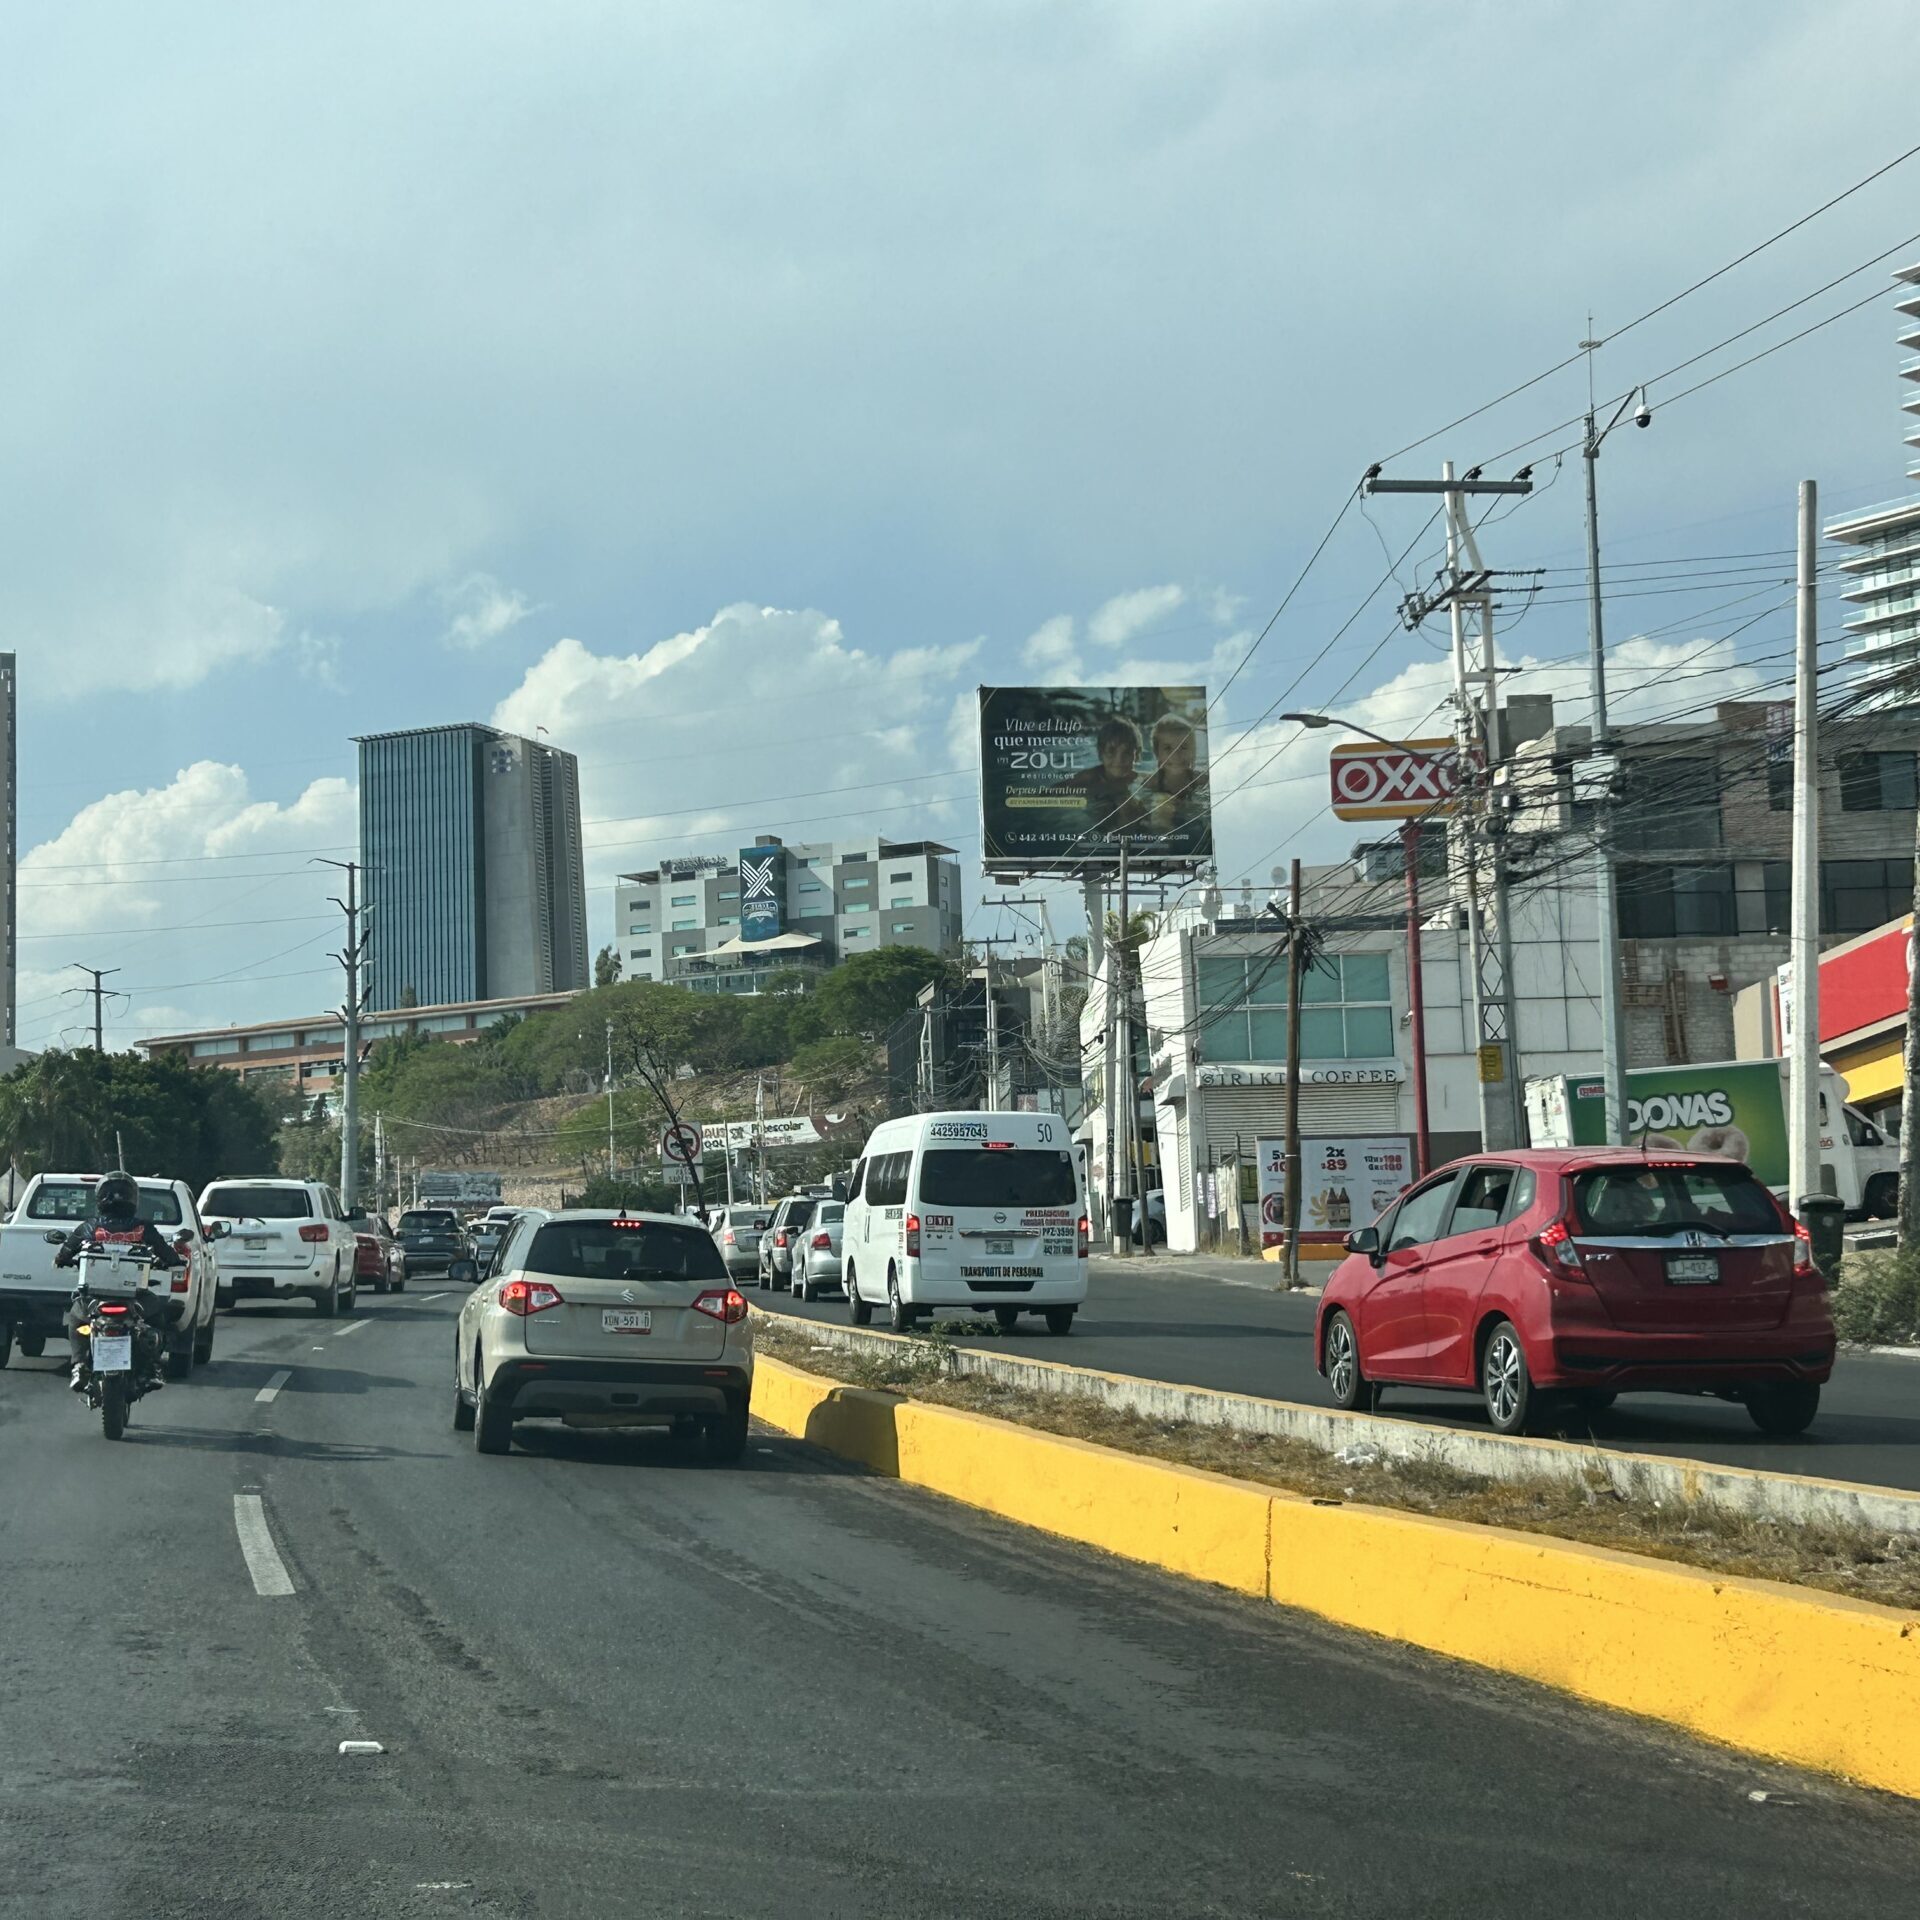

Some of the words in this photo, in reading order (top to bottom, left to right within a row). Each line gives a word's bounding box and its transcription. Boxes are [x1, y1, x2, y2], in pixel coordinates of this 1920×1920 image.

[1006, 718, 1035, 731] Vive
[1038, 718, 1051, 731] el
[1055, 718, 1082, 734] lujo
[994, 736, 1023, 750] que
[1027, 736, 1091, 747] mereces
[1311, 1069, 1397, 1084] COFFEE
[1628, 1091, 1732, 1131] DONAS
[1037, 1123, 1053, 1142] 50
[1326, 1146, 1345, 1158] 2x
[1003, 1266, 1011, 1277] DE
[1012, 1266, 1044, 1277] PERSONAL
